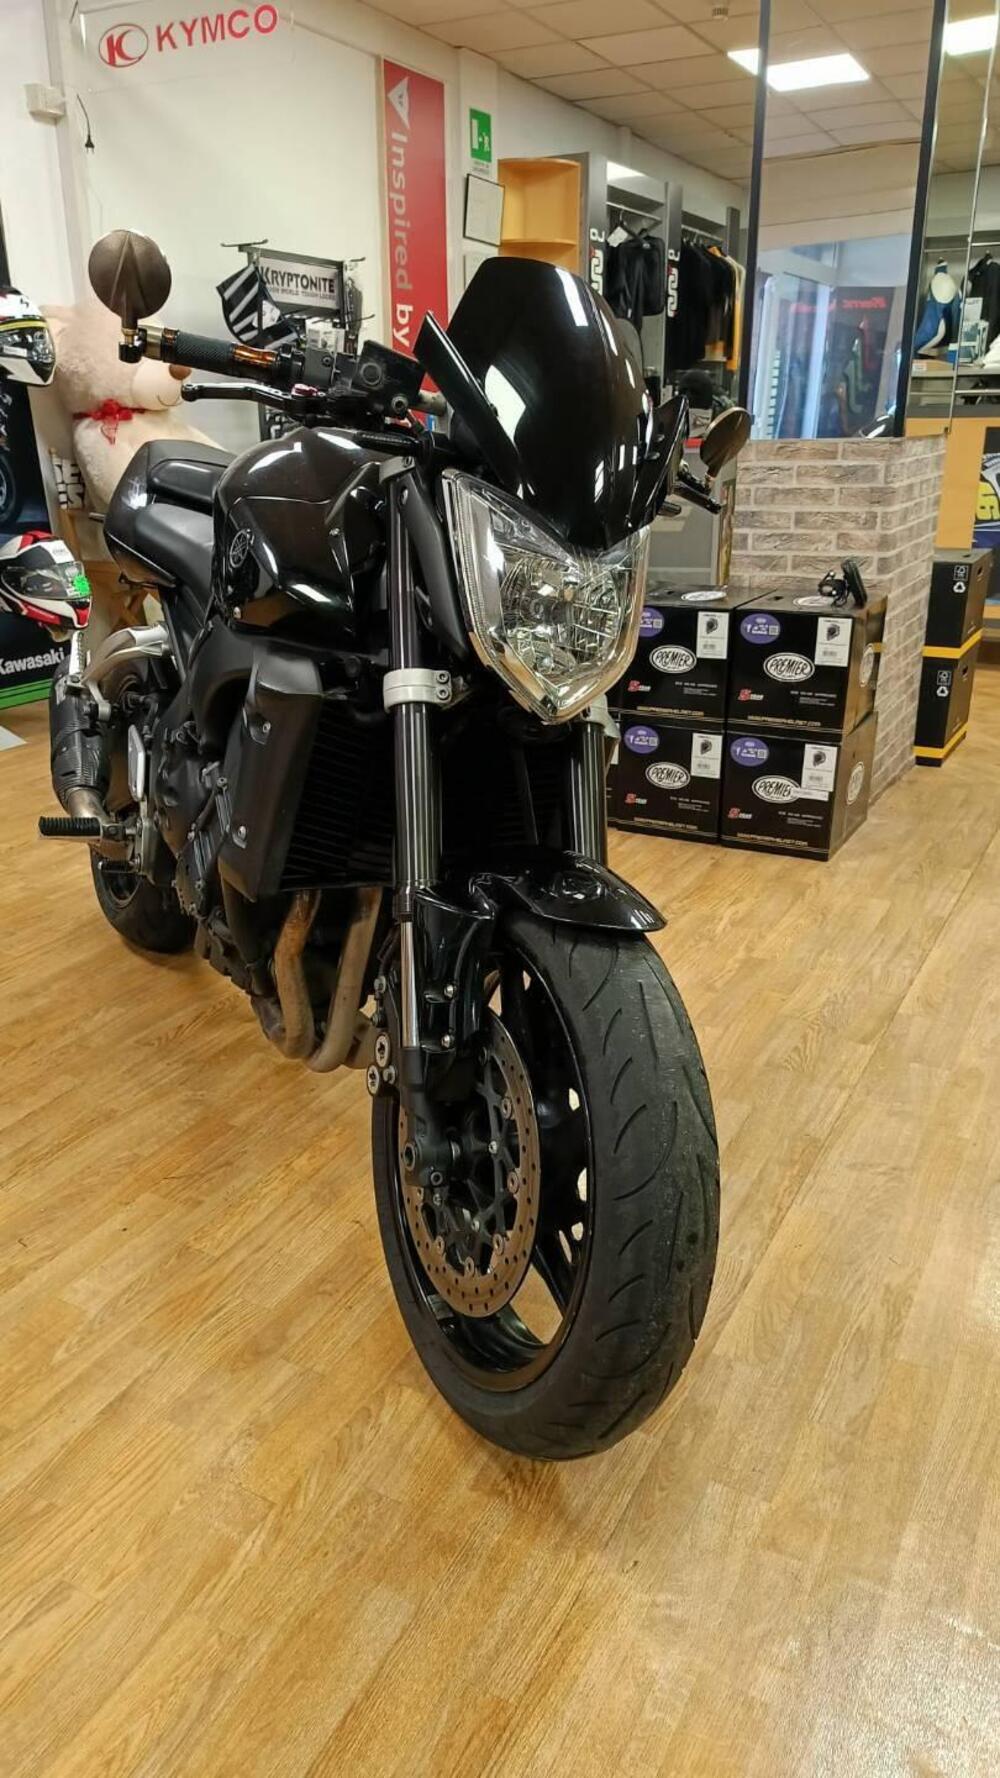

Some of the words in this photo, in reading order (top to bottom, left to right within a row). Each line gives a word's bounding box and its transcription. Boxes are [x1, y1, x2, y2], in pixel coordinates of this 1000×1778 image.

[155, 4, 278, 52] KYMCO
[390, 131, 413, 291] Inspired
[261, 266, 335, 294] KRYPTONITE
[393, 303, 413, 347] by
[655, 650, 692, 667] PREMIER
[769, 658, 809, 677] PREMIER
[651, 767, 685, 783] PREMIER
[759, 780, 793, 798] PREMIE
